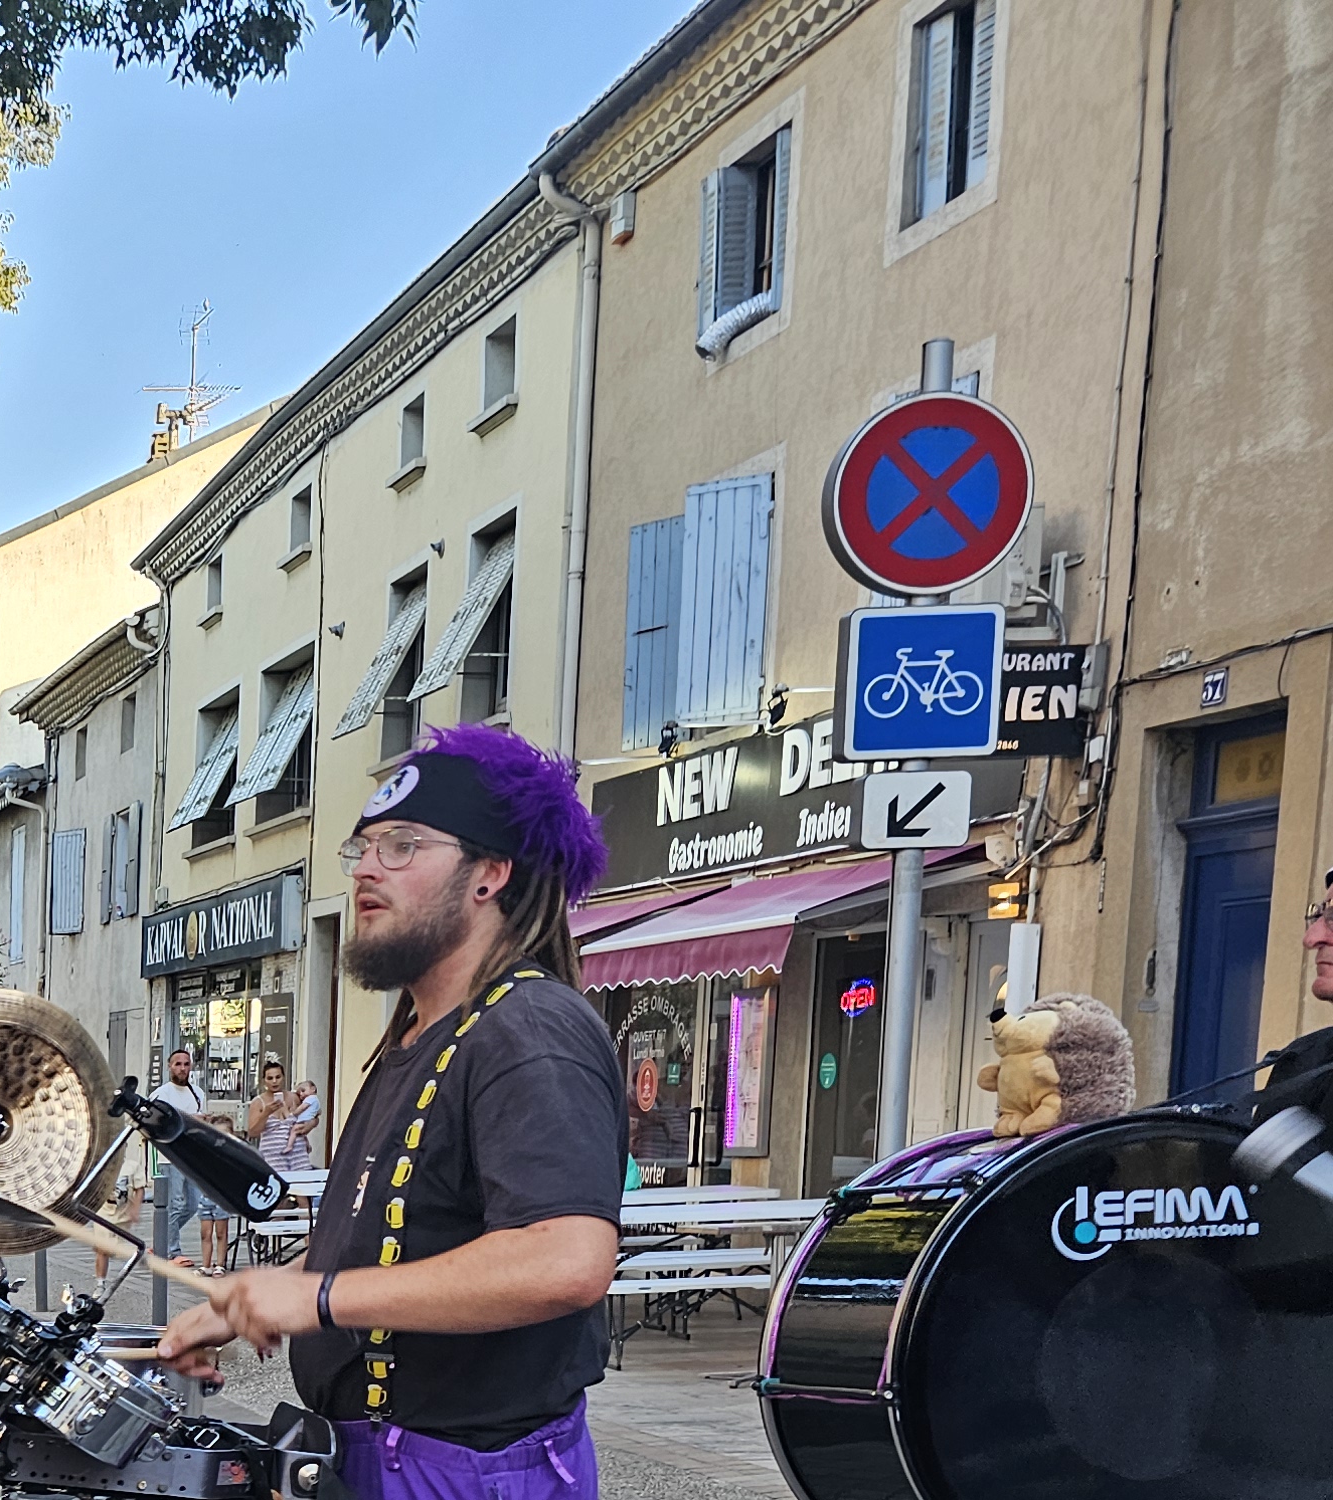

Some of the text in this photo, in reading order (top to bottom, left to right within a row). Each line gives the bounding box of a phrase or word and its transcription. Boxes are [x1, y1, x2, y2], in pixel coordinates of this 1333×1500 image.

[1000, 684, 1077, 722] IEN
[1202, 672, 1225, 701] 37
[656, 747, 739, 827] NEW
[668, 822, 764, 874] Gastronomie
[210, 891, 275, 951] NATIONAL
[840, 983, 876, 1013] OPEN
[633, 1029, 656, 1043] OUVERT
[212, 1068, 239, 1091] ARGENT
[637, 1162, 666, 1188] porter
[1074, 1184, 1250, 1244] LEFIMA
